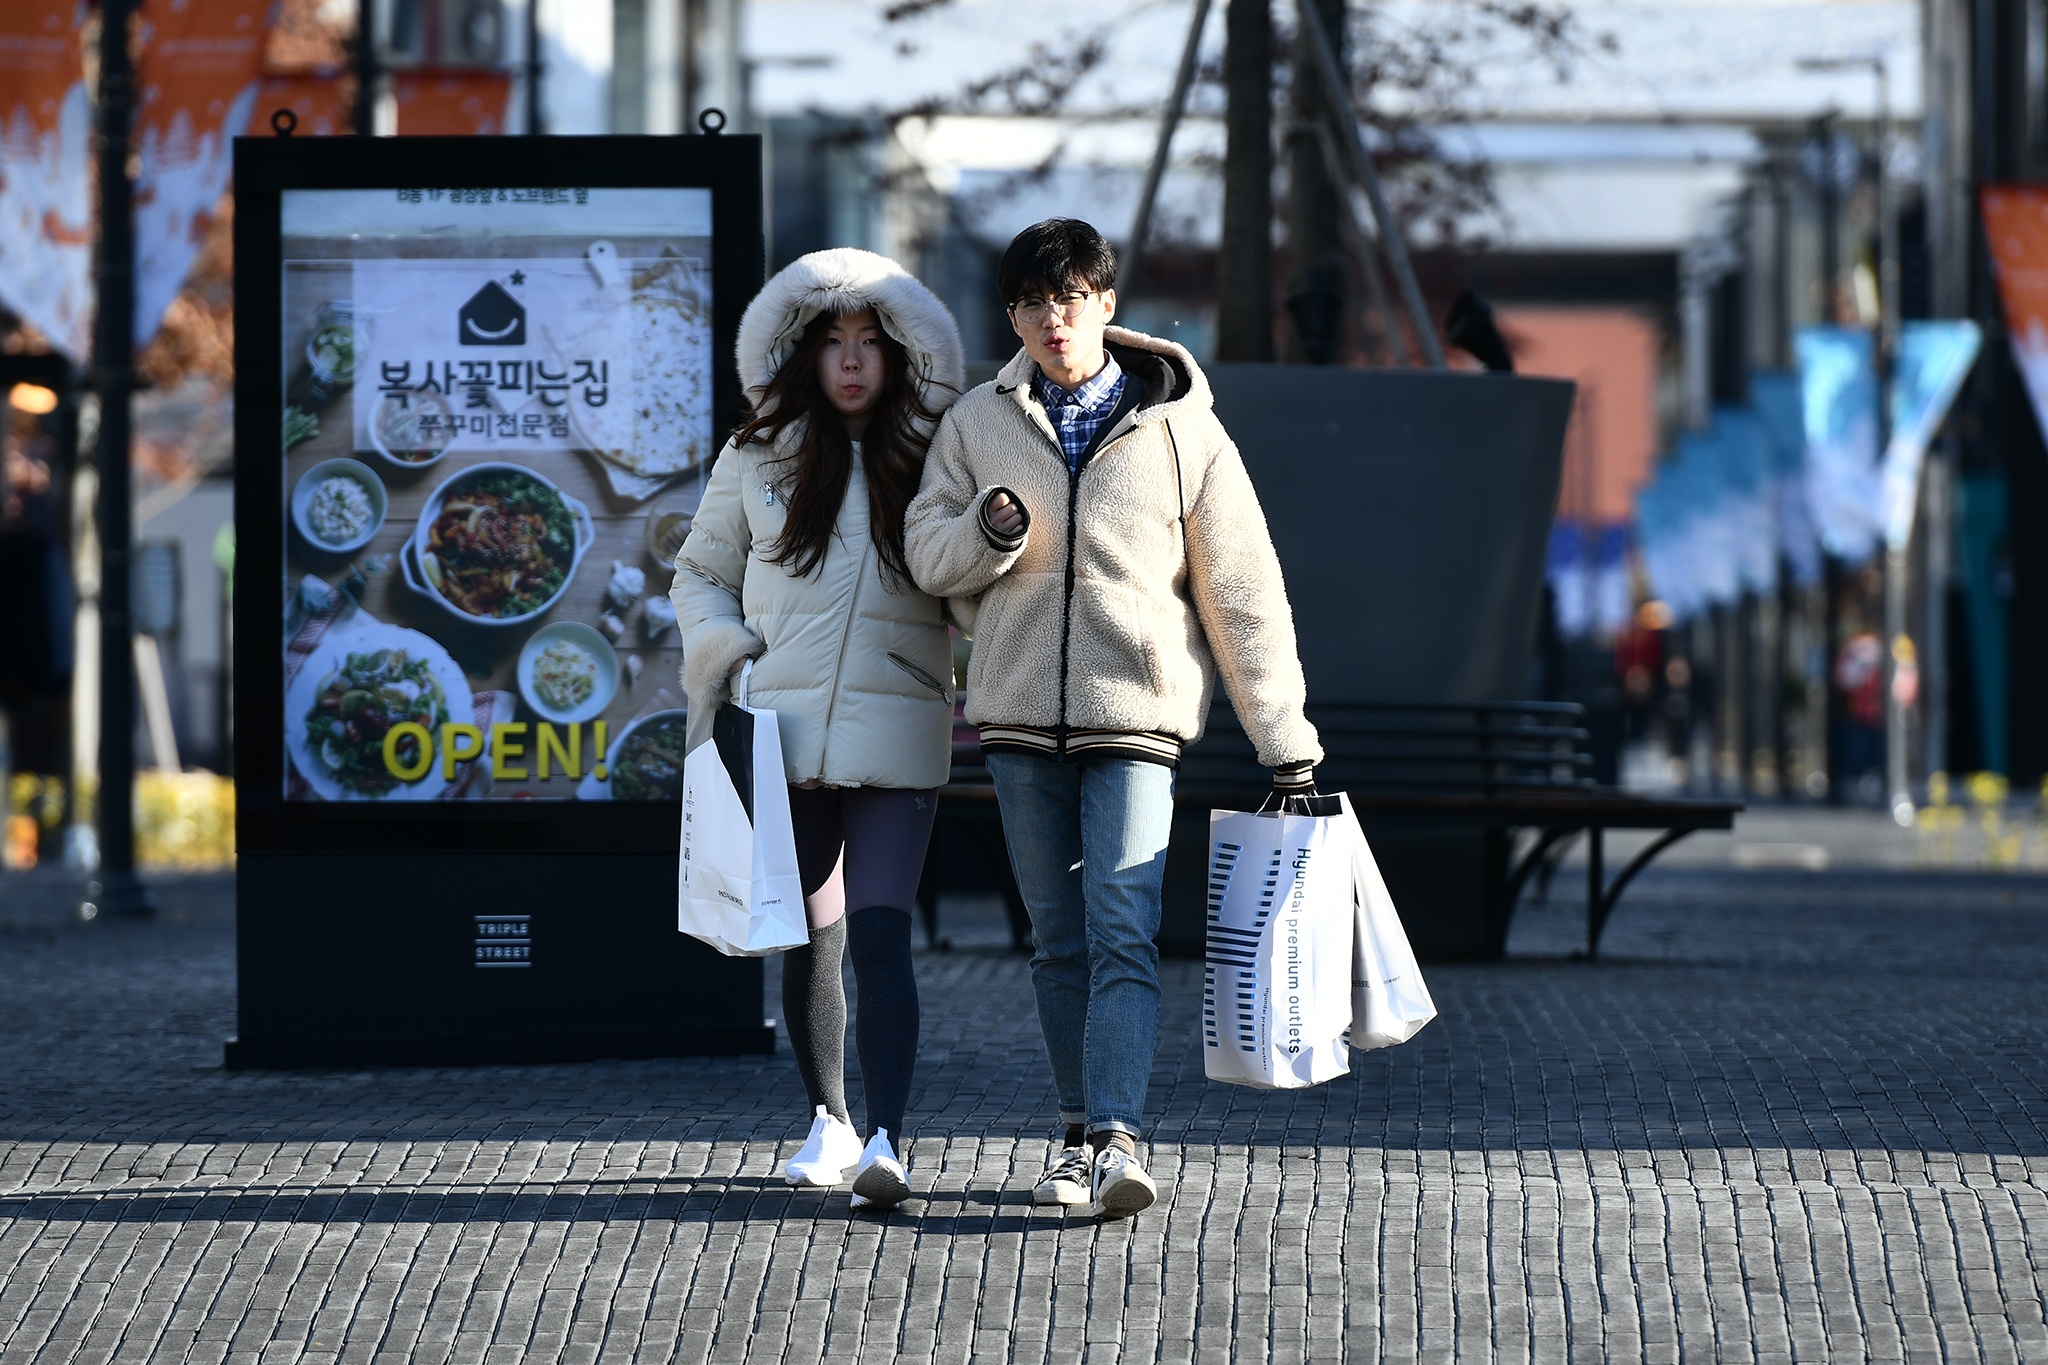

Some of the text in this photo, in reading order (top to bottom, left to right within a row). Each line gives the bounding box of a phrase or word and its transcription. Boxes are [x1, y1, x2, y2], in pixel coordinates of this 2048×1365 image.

[378, 360, 609, 408] 복사꽃피는집
[382, 720, 609, 782] OPEN!
[477, 923, 529, 936] TRIPLE
[475, 946, 531, 959] STREET
[1286, 848, 1312, 1054] Hyundai premium outlets
[1262, 987, 1270, 1015] Hyundai
